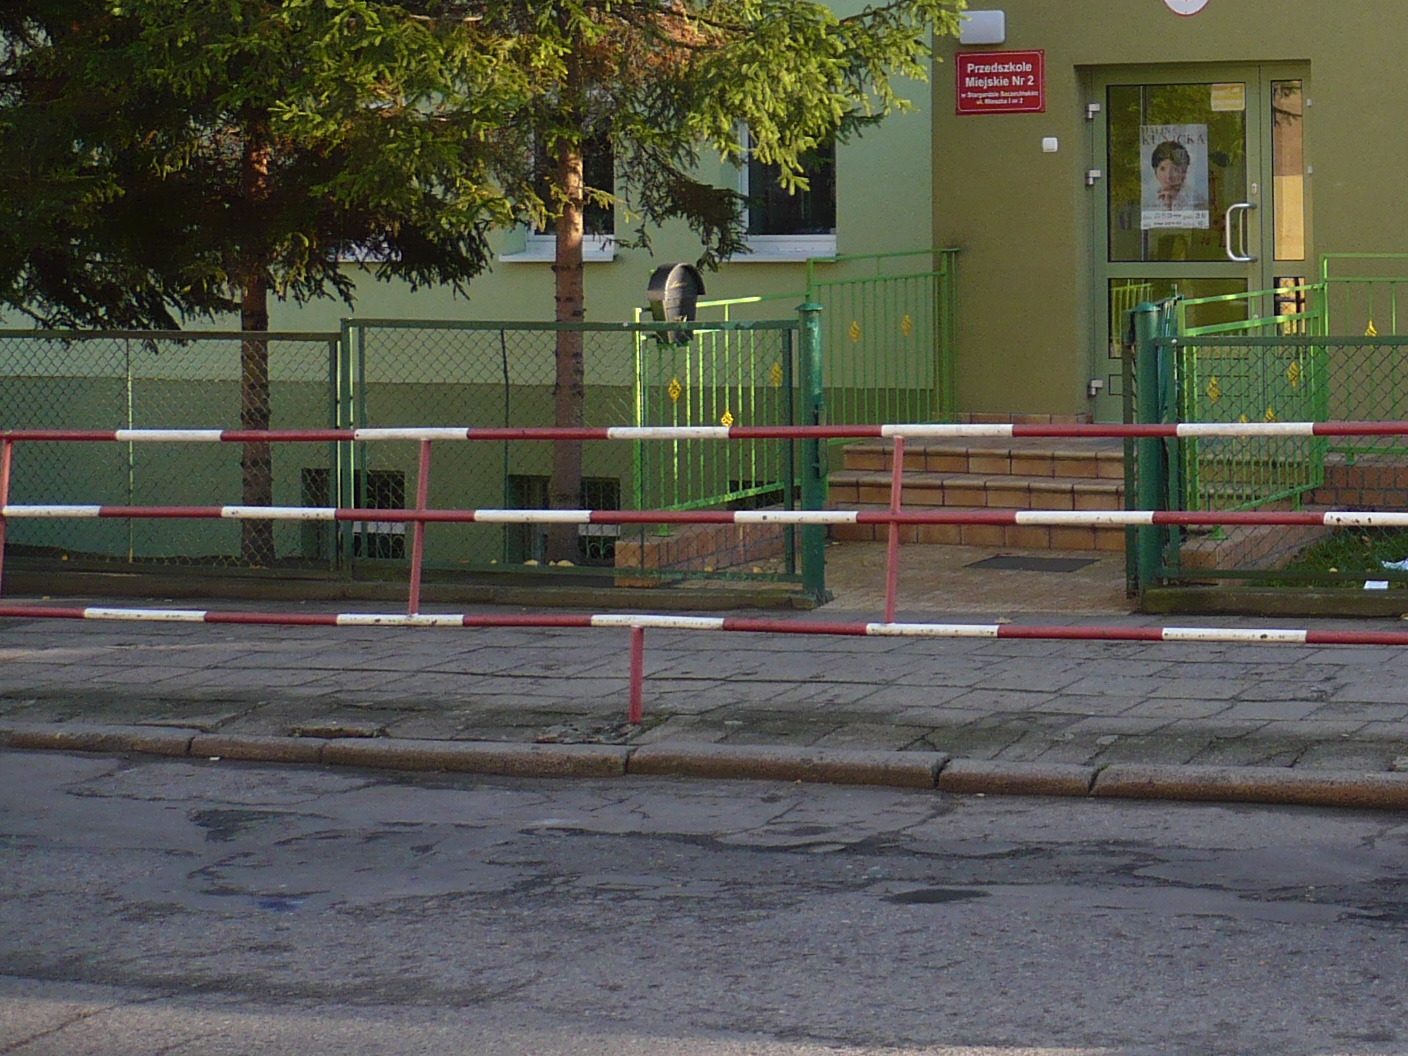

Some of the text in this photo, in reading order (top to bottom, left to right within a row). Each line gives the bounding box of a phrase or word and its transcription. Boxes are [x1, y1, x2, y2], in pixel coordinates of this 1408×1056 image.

[967, 62, 1032, 73] Przedszkole
[965, 75, 1034, 89] Miejskie Nr 2
